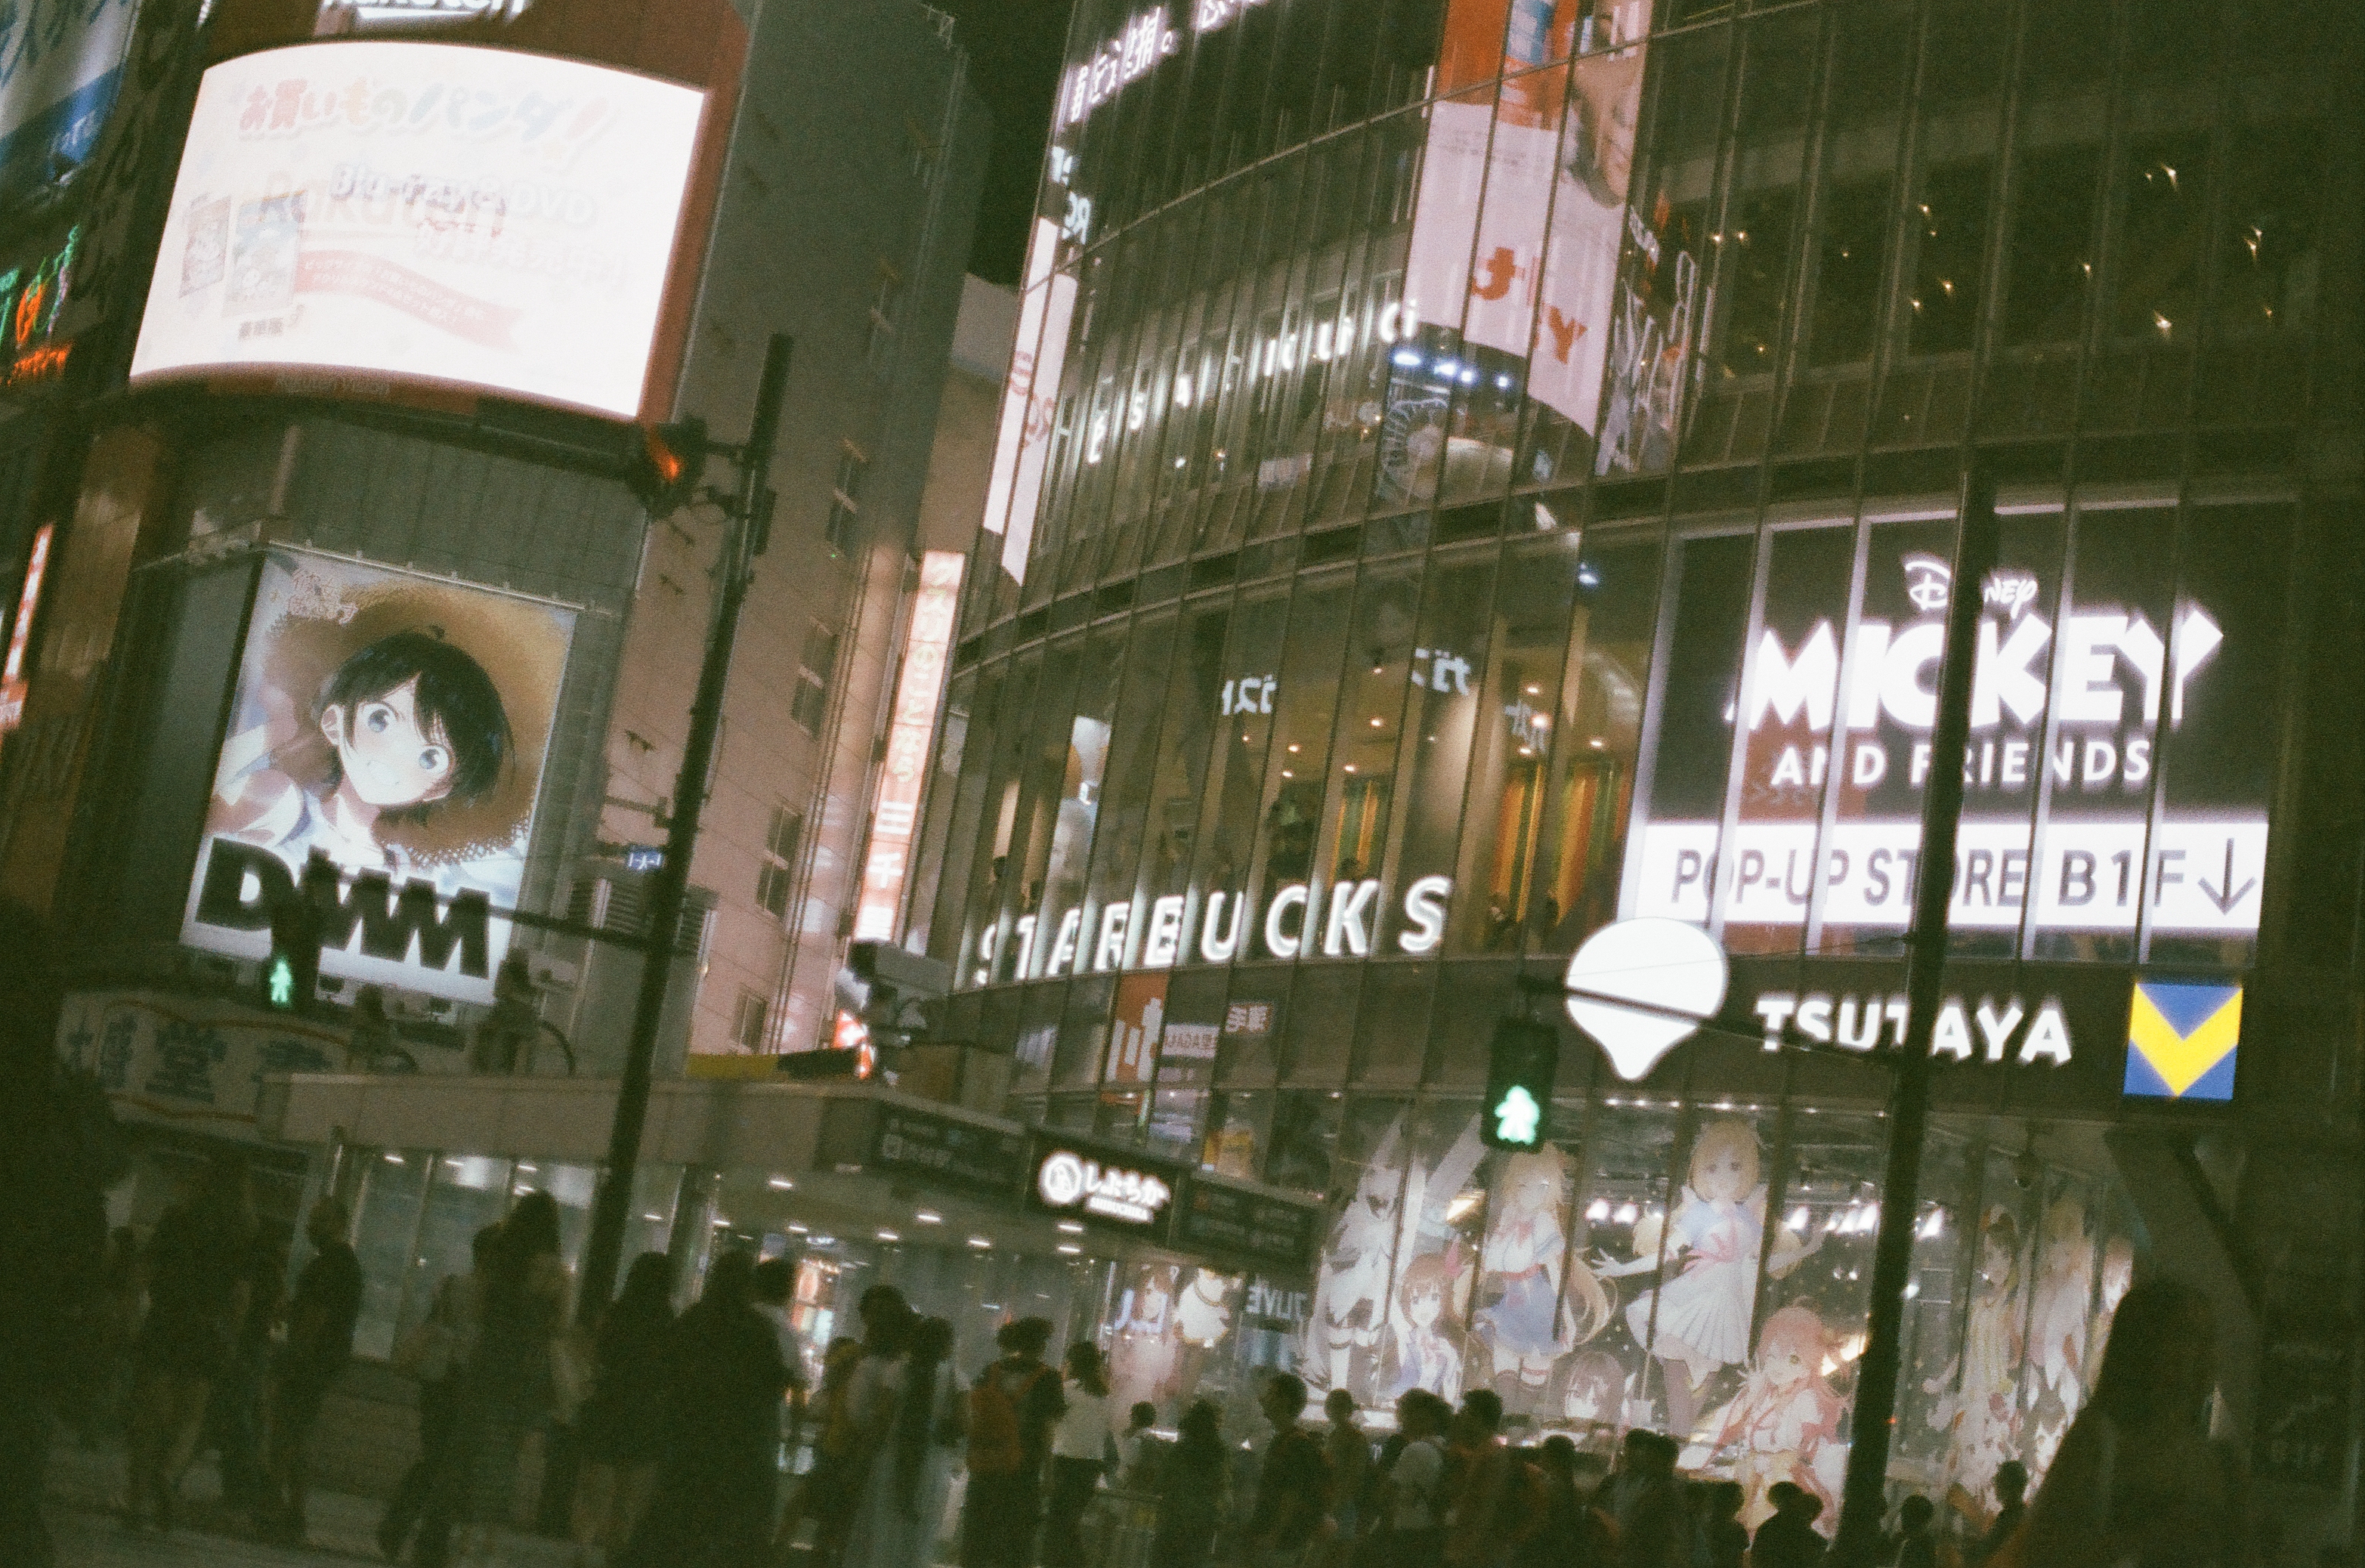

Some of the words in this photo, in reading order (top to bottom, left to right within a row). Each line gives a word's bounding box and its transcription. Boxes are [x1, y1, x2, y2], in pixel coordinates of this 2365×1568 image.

[1905, 560, 2039, 619] Dney
[1725, 609, 2224, 731] MICKEY
[195, 837, 490, 980] DMM
[1671, 847, 1850, 906] POP-UP
